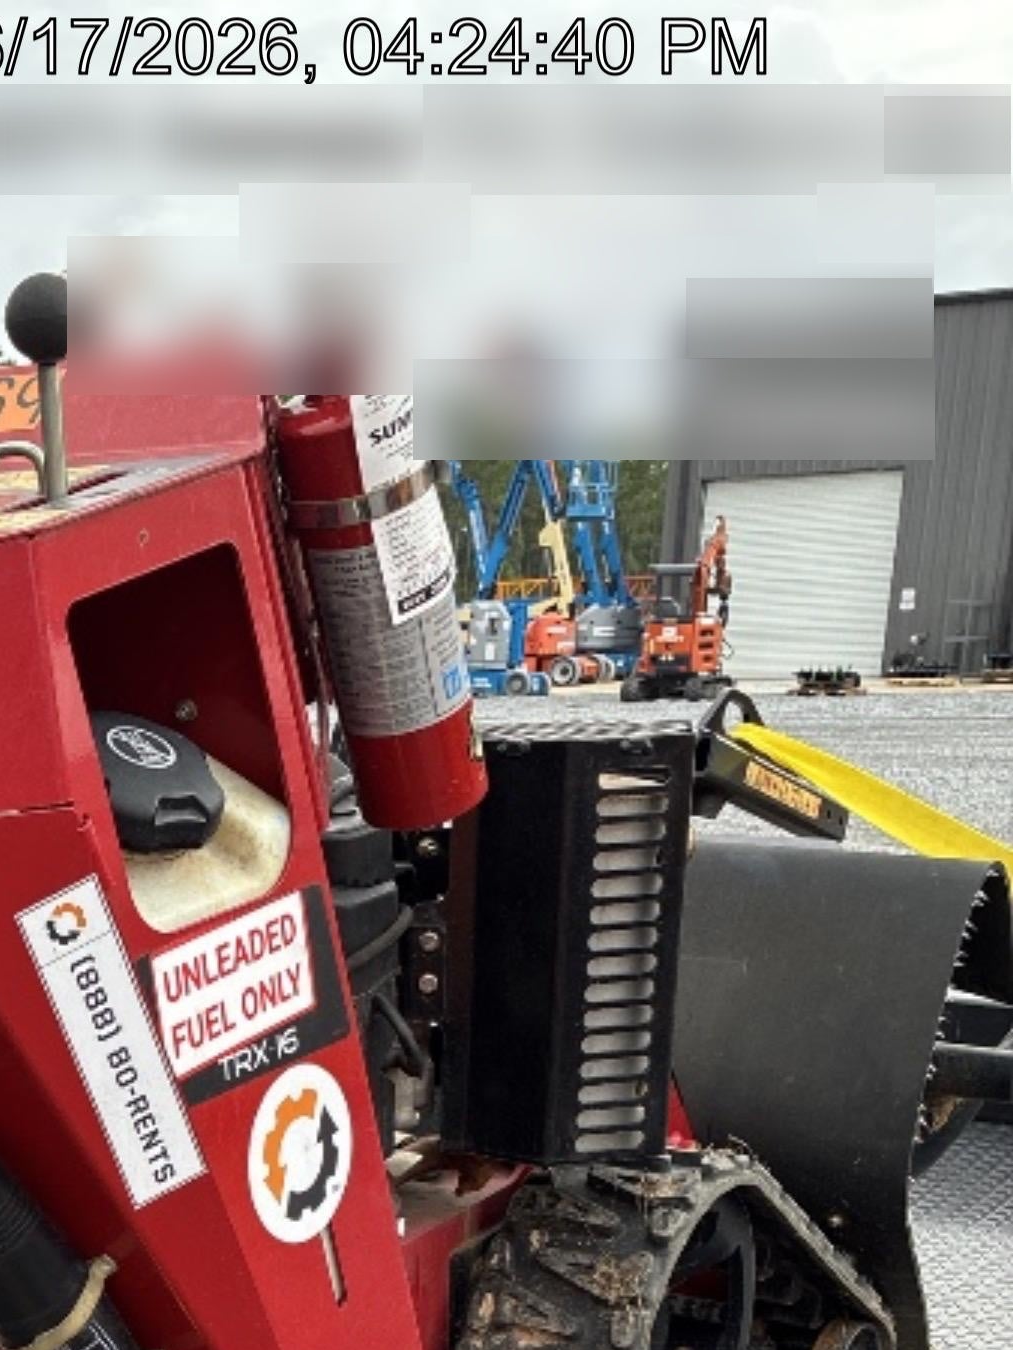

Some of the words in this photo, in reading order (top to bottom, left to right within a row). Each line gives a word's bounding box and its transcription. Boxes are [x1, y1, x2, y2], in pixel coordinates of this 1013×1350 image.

[163, 913, 297, 1003] UNLEADED
[172, 1001, 236, 1059] FUEL
[242, 962, 300, 1020] ONLY
[70, 954, 122, 1041] (888)
[107, 1046, 176, 1183] 80-RENTS
